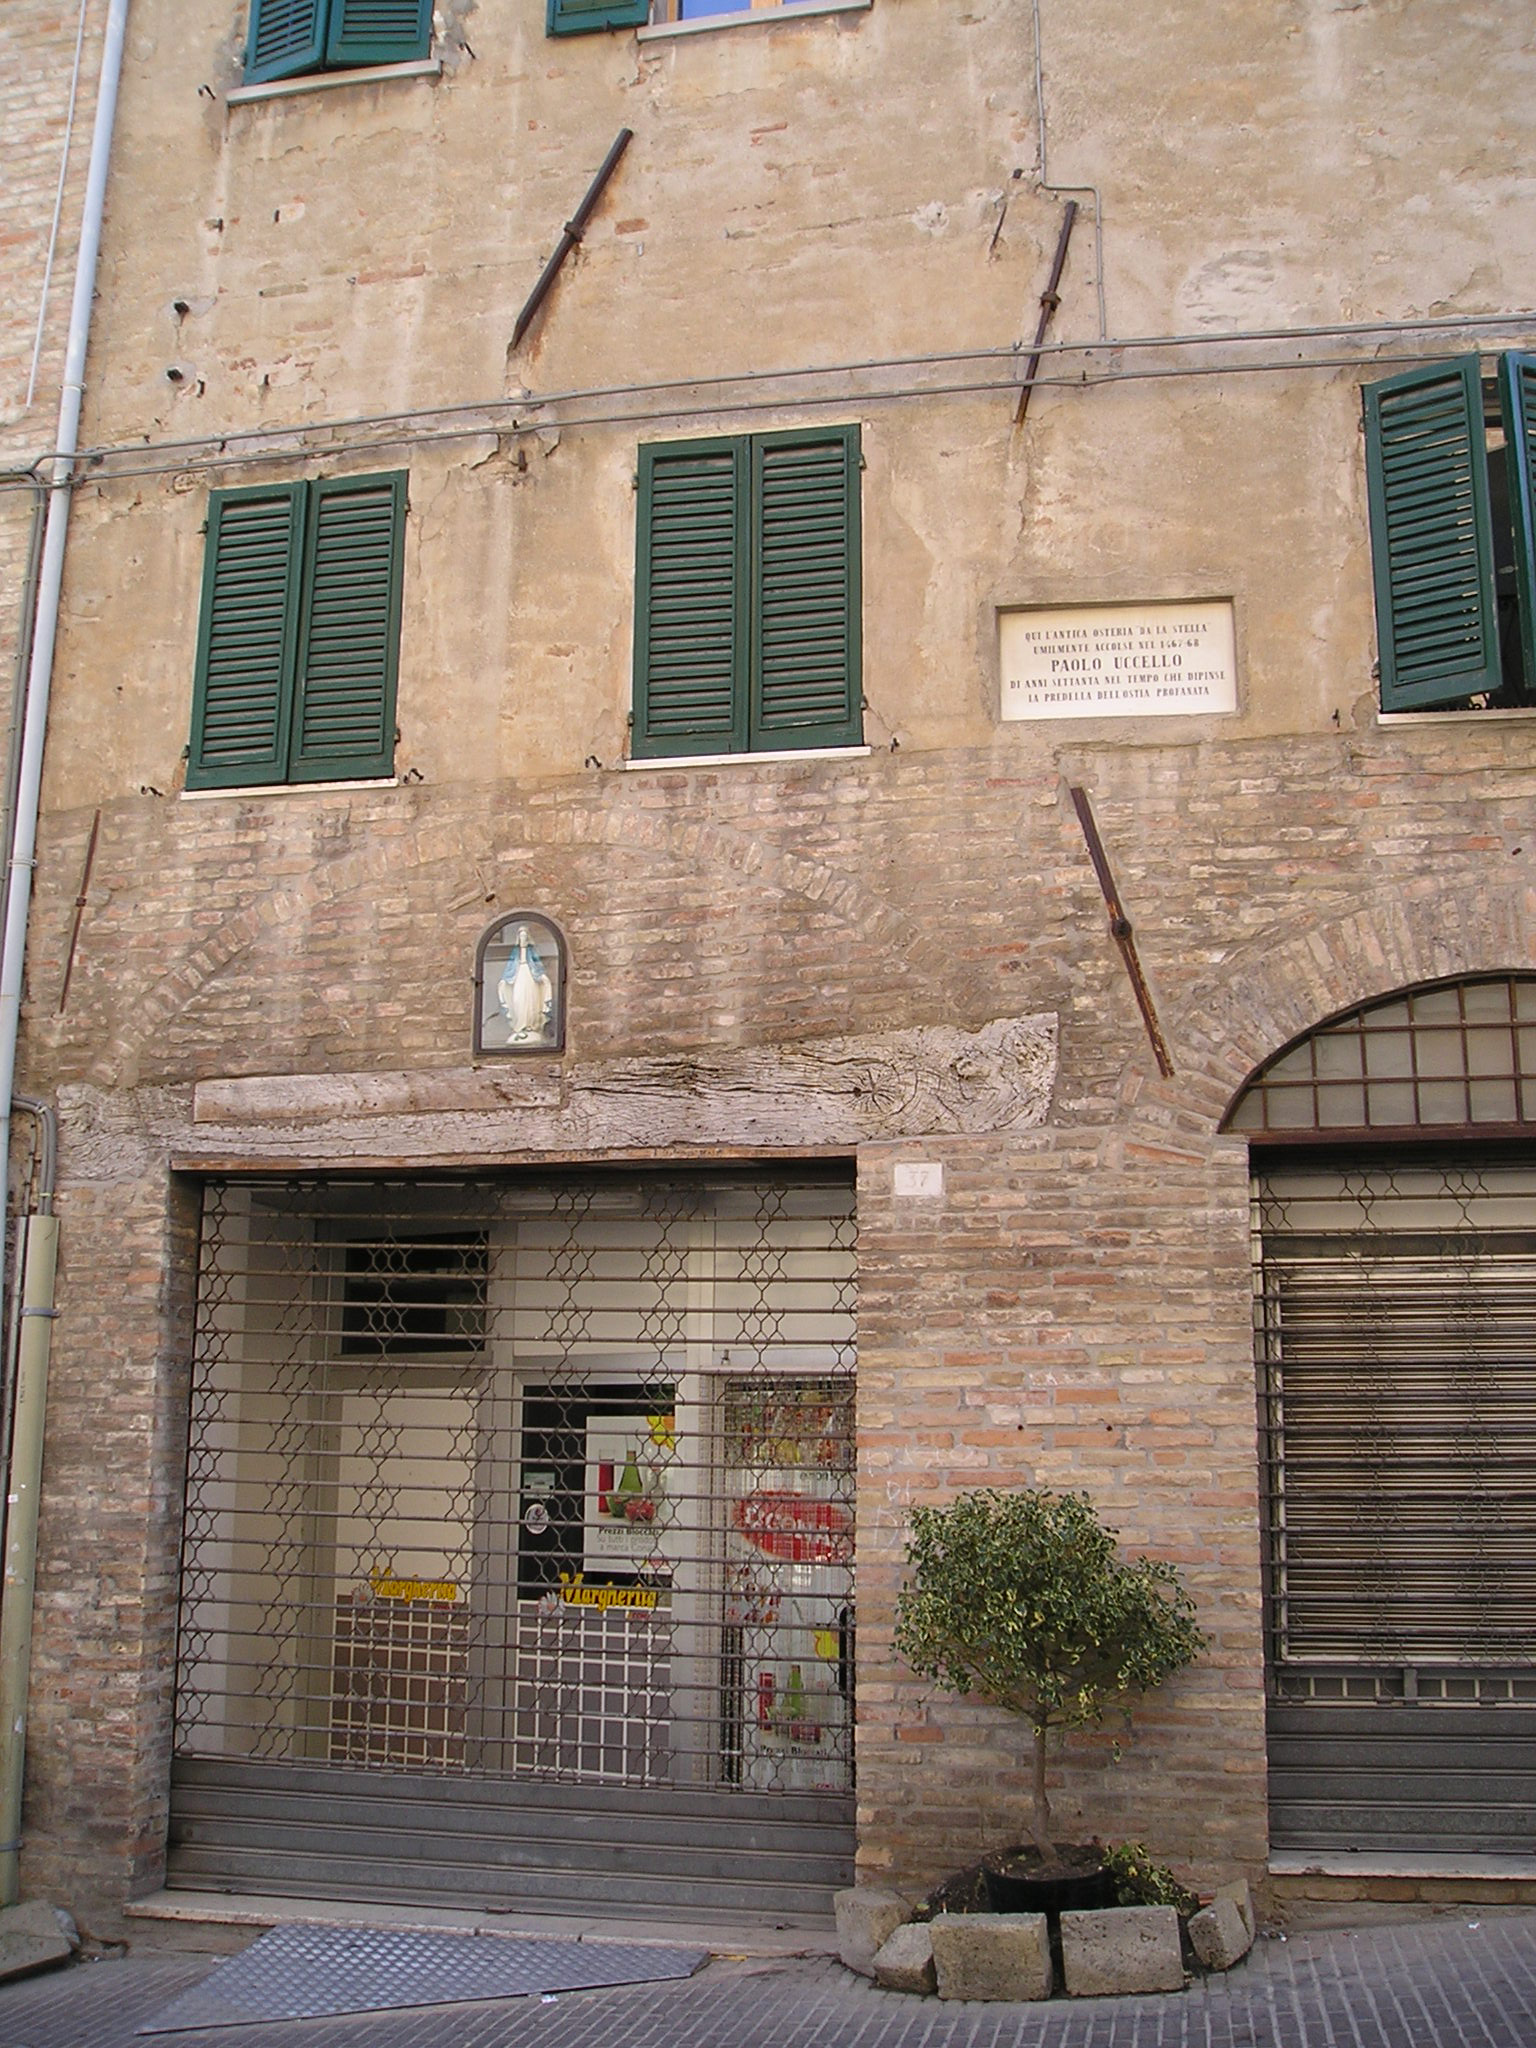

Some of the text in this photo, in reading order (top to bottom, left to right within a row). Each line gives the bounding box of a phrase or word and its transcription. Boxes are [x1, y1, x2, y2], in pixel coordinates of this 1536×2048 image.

[1025, 632, 1041, 642] QUI
[1093, 627, 1133, 637] OSTERIA
[1156, 625, 1167, 634] LA
[1033, 643, 1089, 654] UMILMENTE
[1095, 641, 1133, 652] ACCOLSE
[1139, 640, 1155, 650] NEL
[1051, 653, 1182, 673] PAOLO UCCELLO
[1010, 670, 1225, 689] DI ANNI SETTANTA NEL TEMPO CHE DIPINSE
[1028, 693, 1039, 703] LA
[1044, 691, 1092, 702] PREDELLA
[1156, 686, 1210, 697] PROFANATA
[370, 1566, 457, 1604] Margherita
[559, 1573, 657, 1612] Margherita
